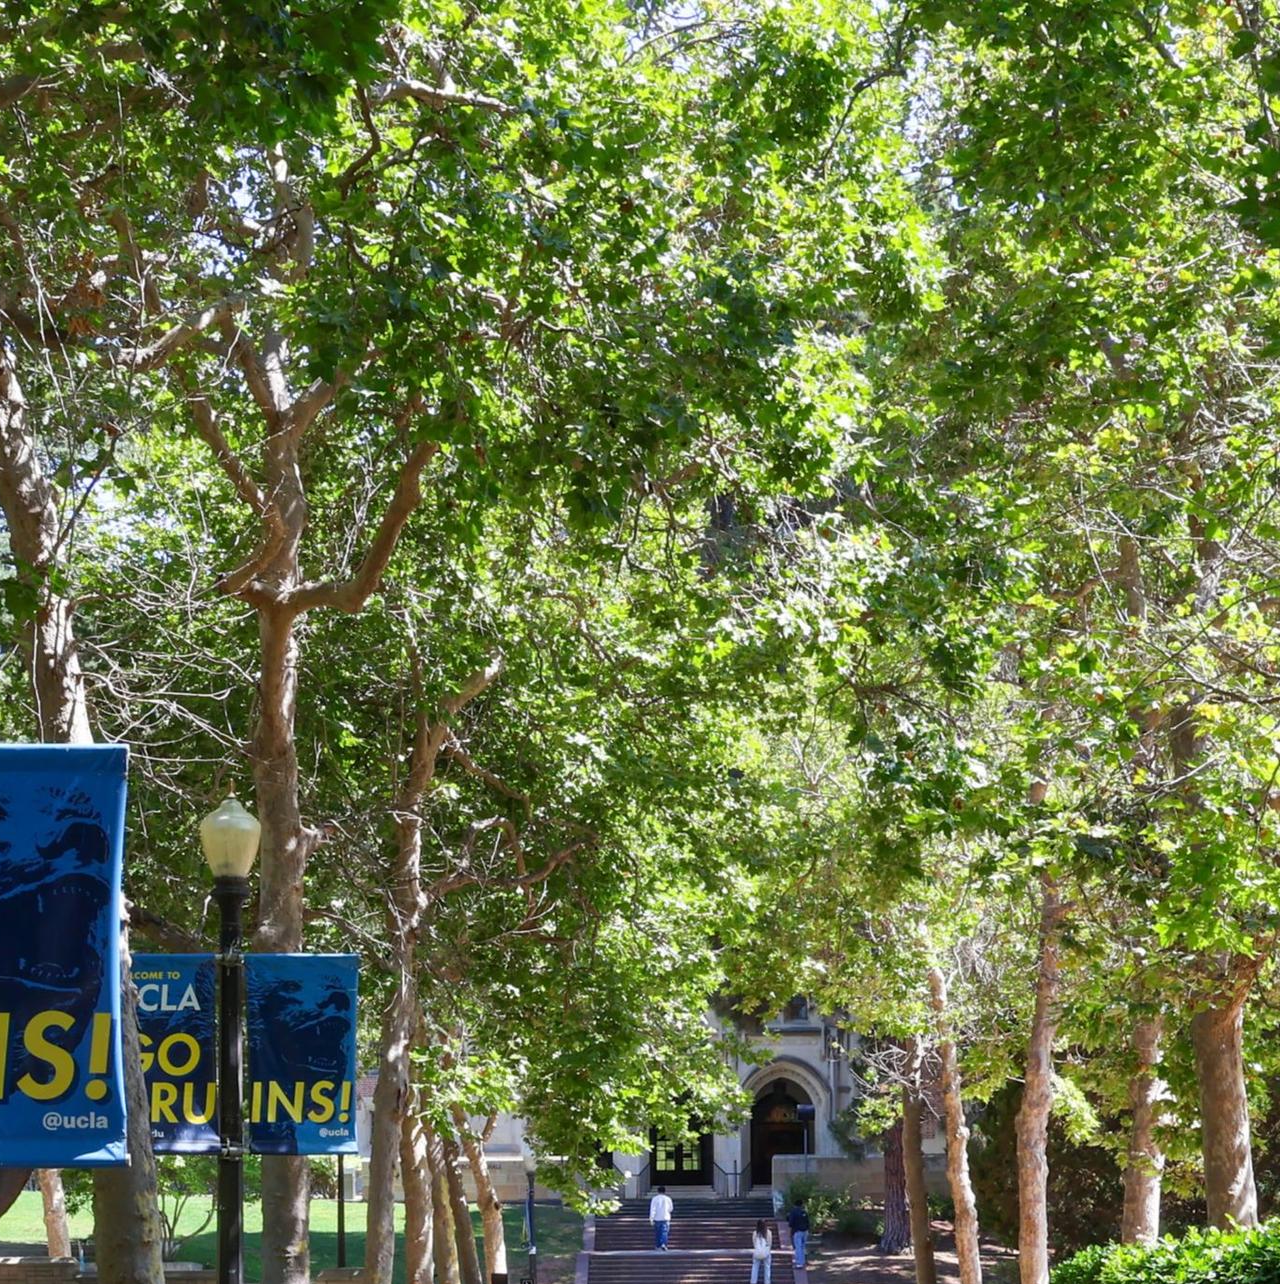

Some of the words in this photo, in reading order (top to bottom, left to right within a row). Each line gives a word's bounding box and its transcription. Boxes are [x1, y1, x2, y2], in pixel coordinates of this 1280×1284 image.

[168, 971, 180, 979] TO
[138, 983, 201, 1012] CLA
[150, 1081, 217, 1125] RU
[42, 1111, 109, 1130] @ucla
[319, 1127, 350, 1138] @ucla
